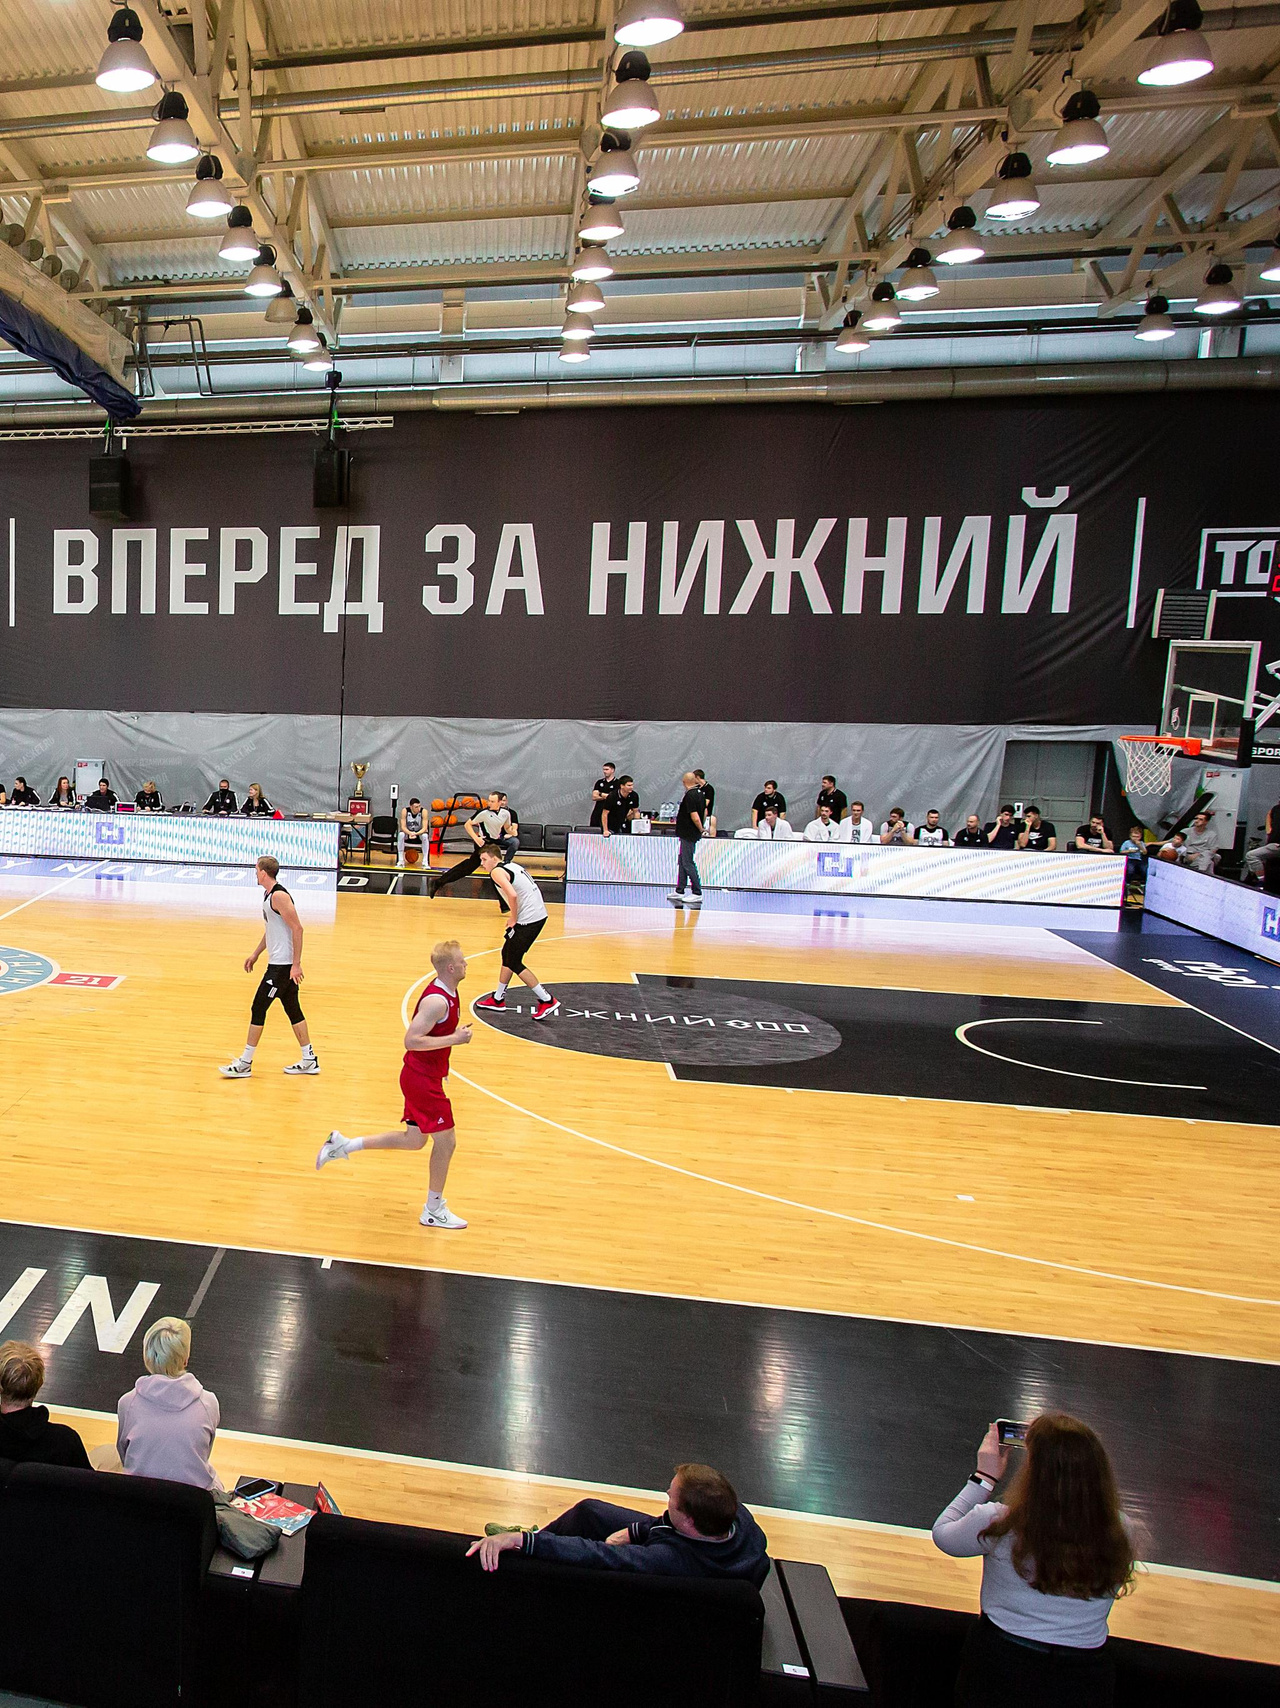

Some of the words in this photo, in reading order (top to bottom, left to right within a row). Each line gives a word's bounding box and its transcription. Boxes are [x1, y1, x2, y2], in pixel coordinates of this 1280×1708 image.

[53, 525, 384, 634] ВПЕРЕД
[422, 523, 544, 616] ЗА
[588, 486, 1078, 616] НИЖНИЙ
[65, 976, 101, 985] 21
